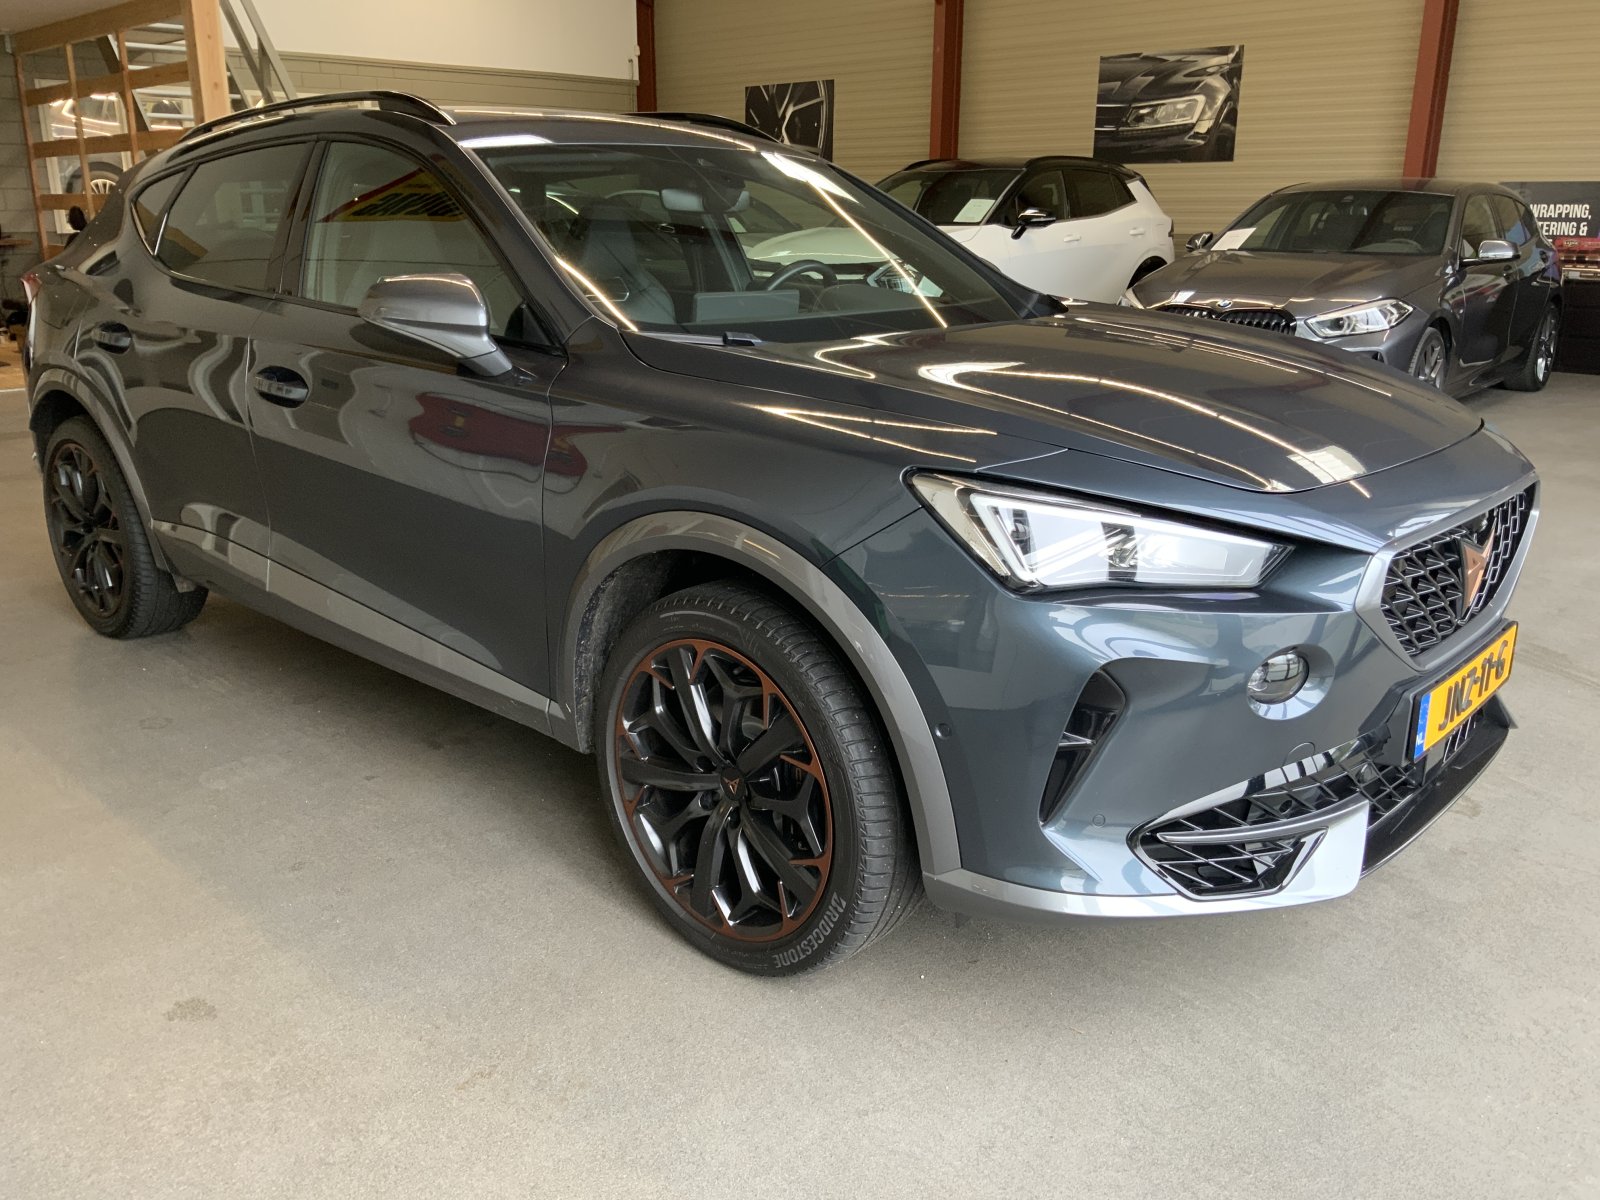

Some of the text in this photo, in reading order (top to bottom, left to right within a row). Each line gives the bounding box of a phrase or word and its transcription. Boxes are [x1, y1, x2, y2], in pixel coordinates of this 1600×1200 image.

[1530, 204, 1592, 220] WRAPPING,
[1579, 221, 1588, 236] &
[771, 892, 847, 968] BRIDGESTONE
